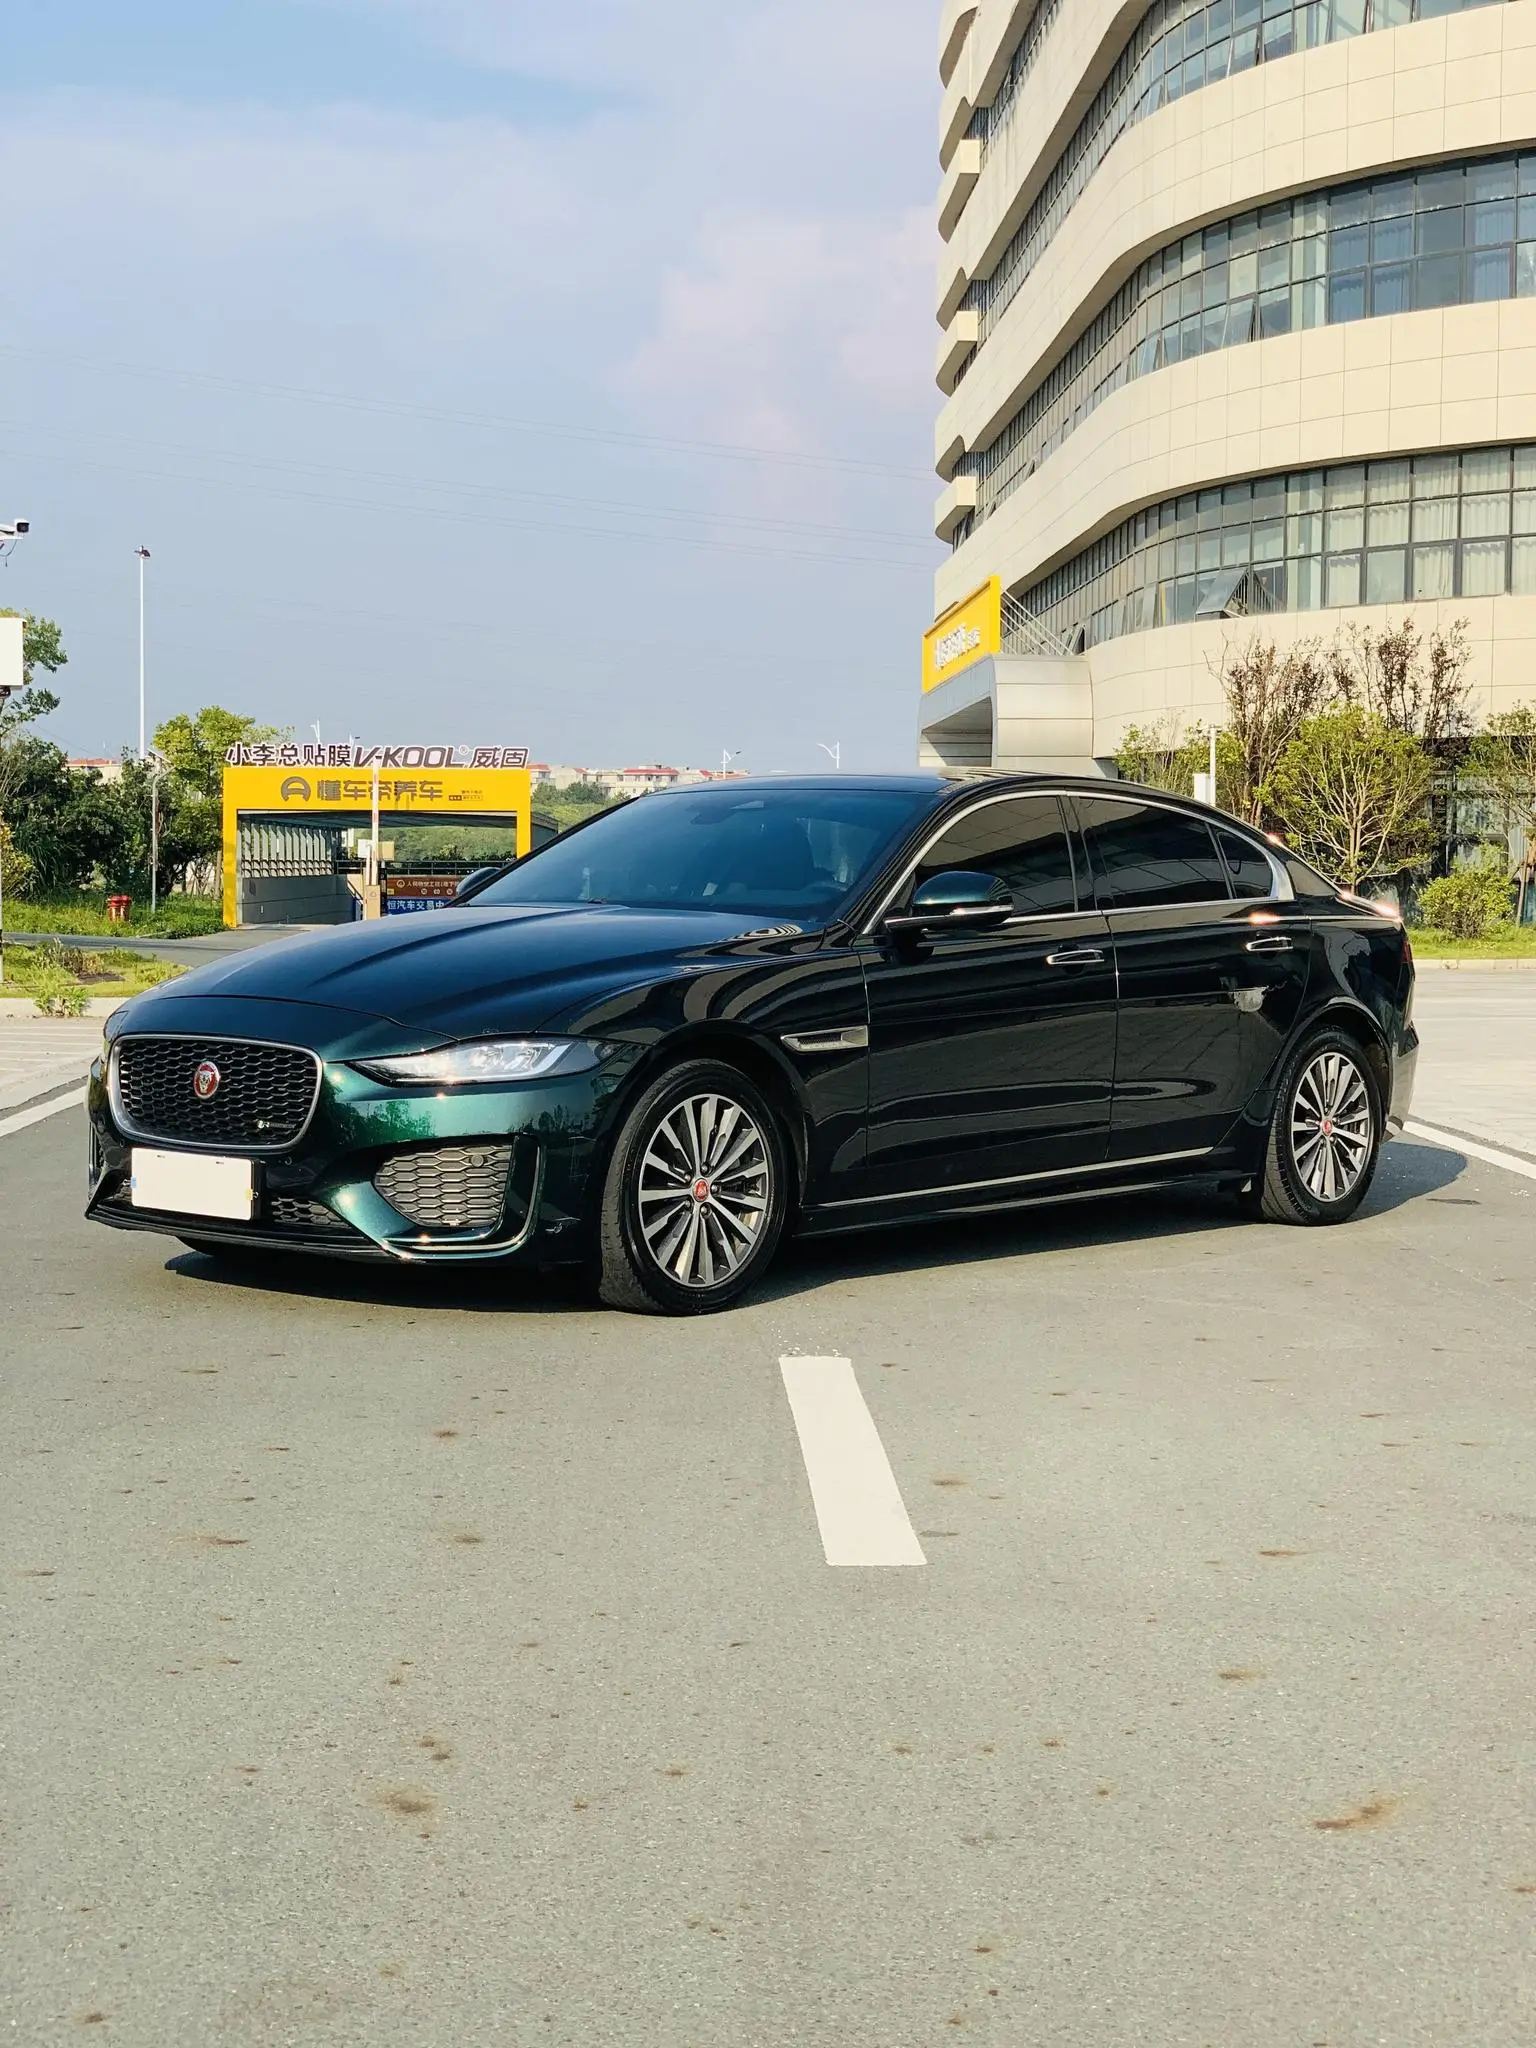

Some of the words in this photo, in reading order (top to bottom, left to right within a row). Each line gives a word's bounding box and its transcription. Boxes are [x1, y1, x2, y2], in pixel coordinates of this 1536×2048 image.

[226, 743, 351, 767] 小李总贴膜
[470, 746, 529, 769] 威固
